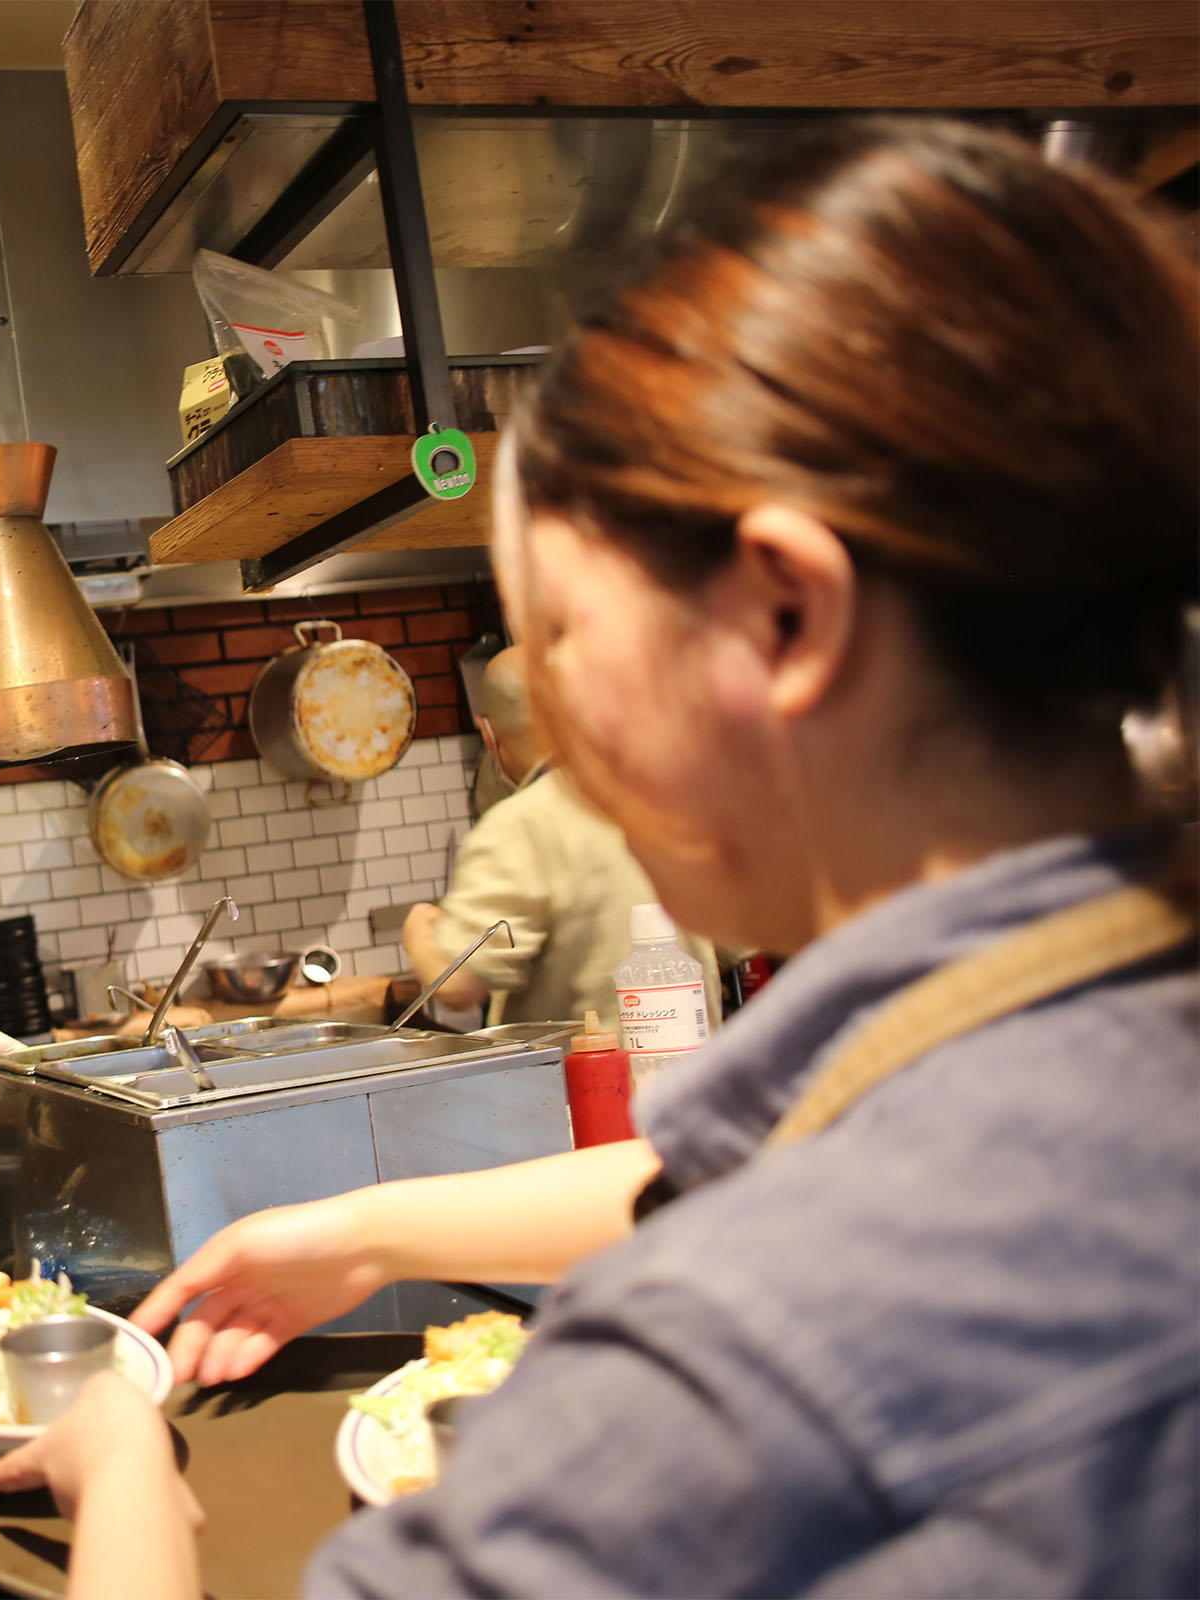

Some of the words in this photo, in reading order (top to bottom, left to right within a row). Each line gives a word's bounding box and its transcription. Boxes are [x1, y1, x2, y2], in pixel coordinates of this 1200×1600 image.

[433, 472, 470, 492] Newton
[637, 1008, 677, 1019] ドレッシング
